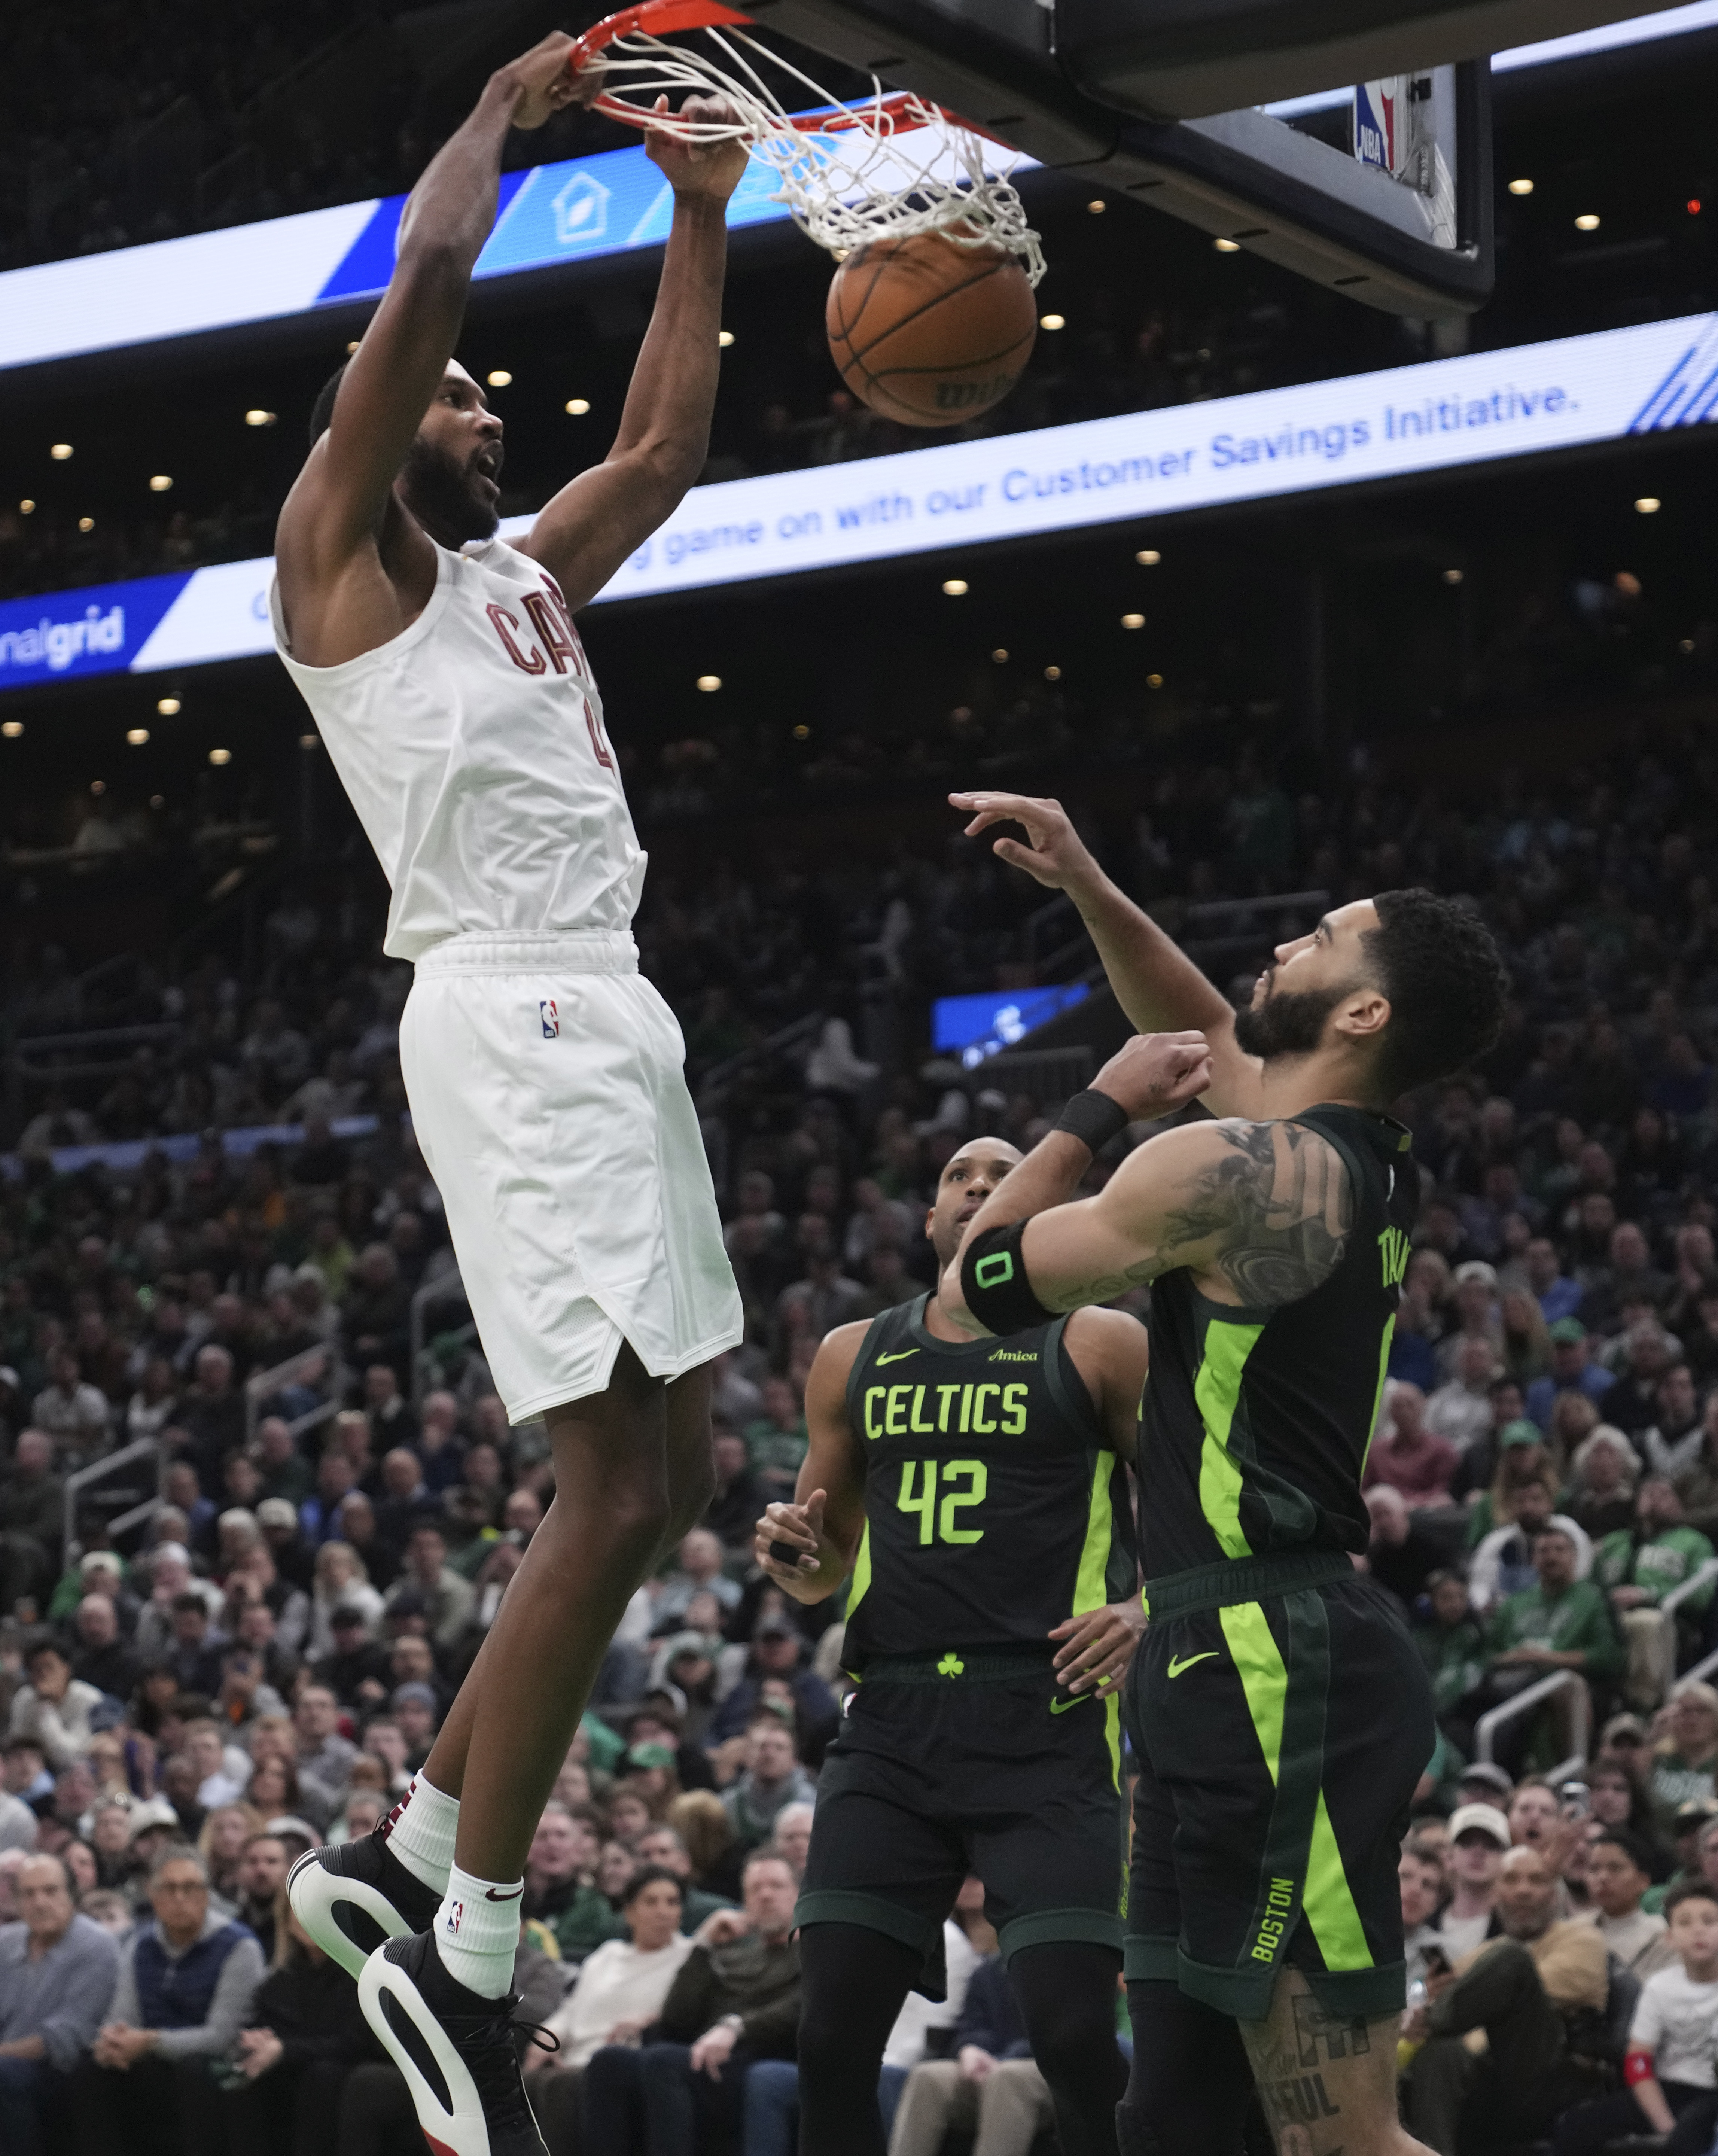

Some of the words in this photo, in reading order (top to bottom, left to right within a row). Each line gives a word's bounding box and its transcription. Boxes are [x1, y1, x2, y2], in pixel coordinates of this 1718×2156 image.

[1358, 124, 1382, 164] NBA
[664, 519, 764, 564] game
[778, 510, 822, 539] on
[835, 488, 913, 529] with
[926, 481, 985, 514] our
[1002, 449, 1195, 501] Customer
[1211, 417, 1370, 468] Savings
[1384, 383, 1579, 439] Initiative.
[988, 1348, 1038, 1361] Amica
[865, 1383, 1029, 1440] CELTICS
[897, 1460, 987, 1545] 42
[1251, 1878, 1294, 1963] BOSTON
